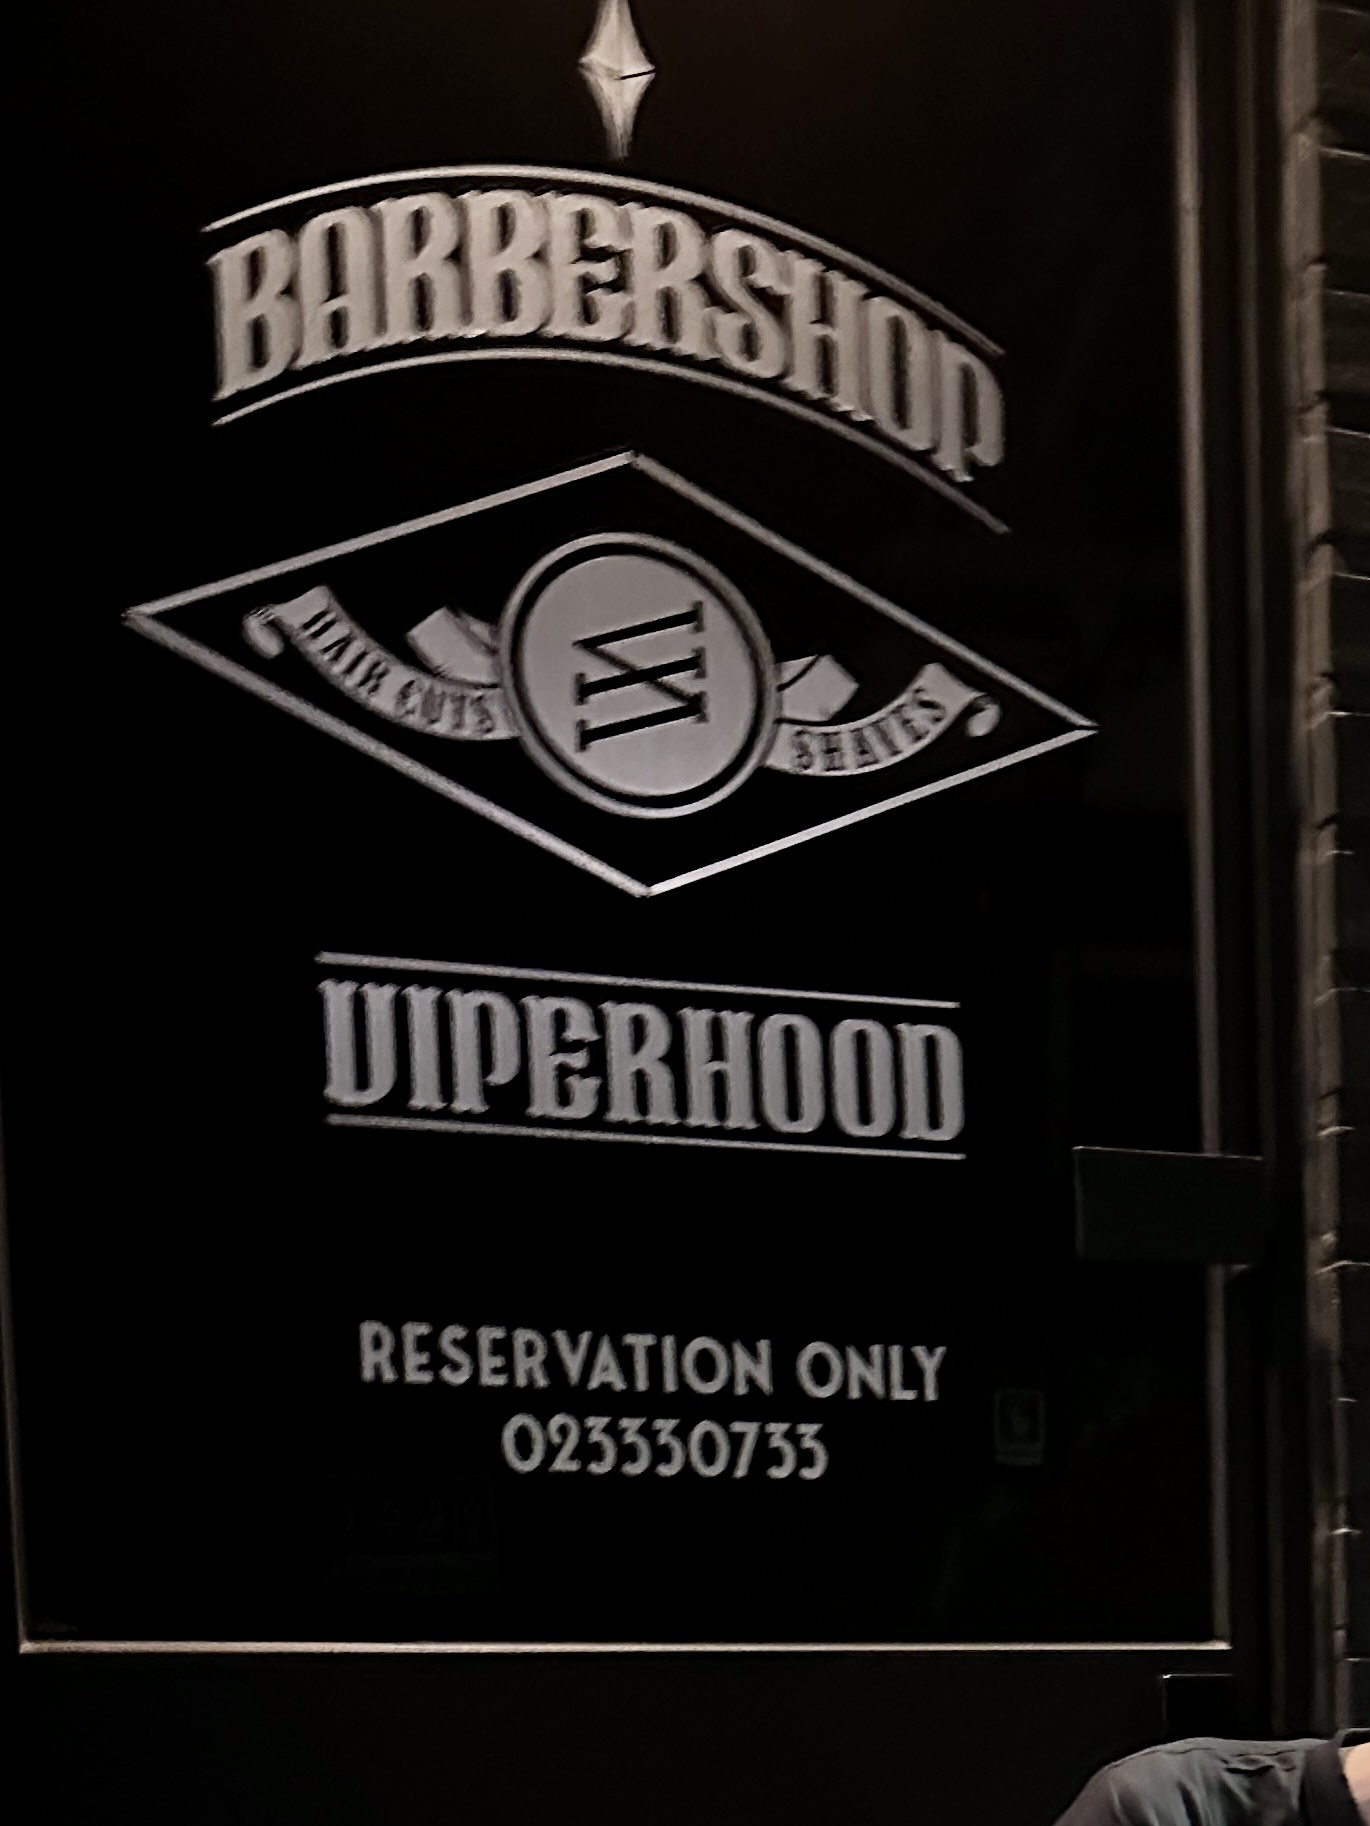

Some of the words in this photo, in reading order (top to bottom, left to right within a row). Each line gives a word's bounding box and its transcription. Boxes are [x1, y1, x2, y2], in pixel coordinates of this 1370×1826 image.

[206, 189, 1004, 482] BARBERSHOP
[302, 608, 391, 696] HAIR
[397, 679, 496, 735] CUTS
[359, 1320, 773, 1396] RESERVATION
[796, 1340, 947, 1402] ONLY
[501, 1412, 829, 1481] 023330733
